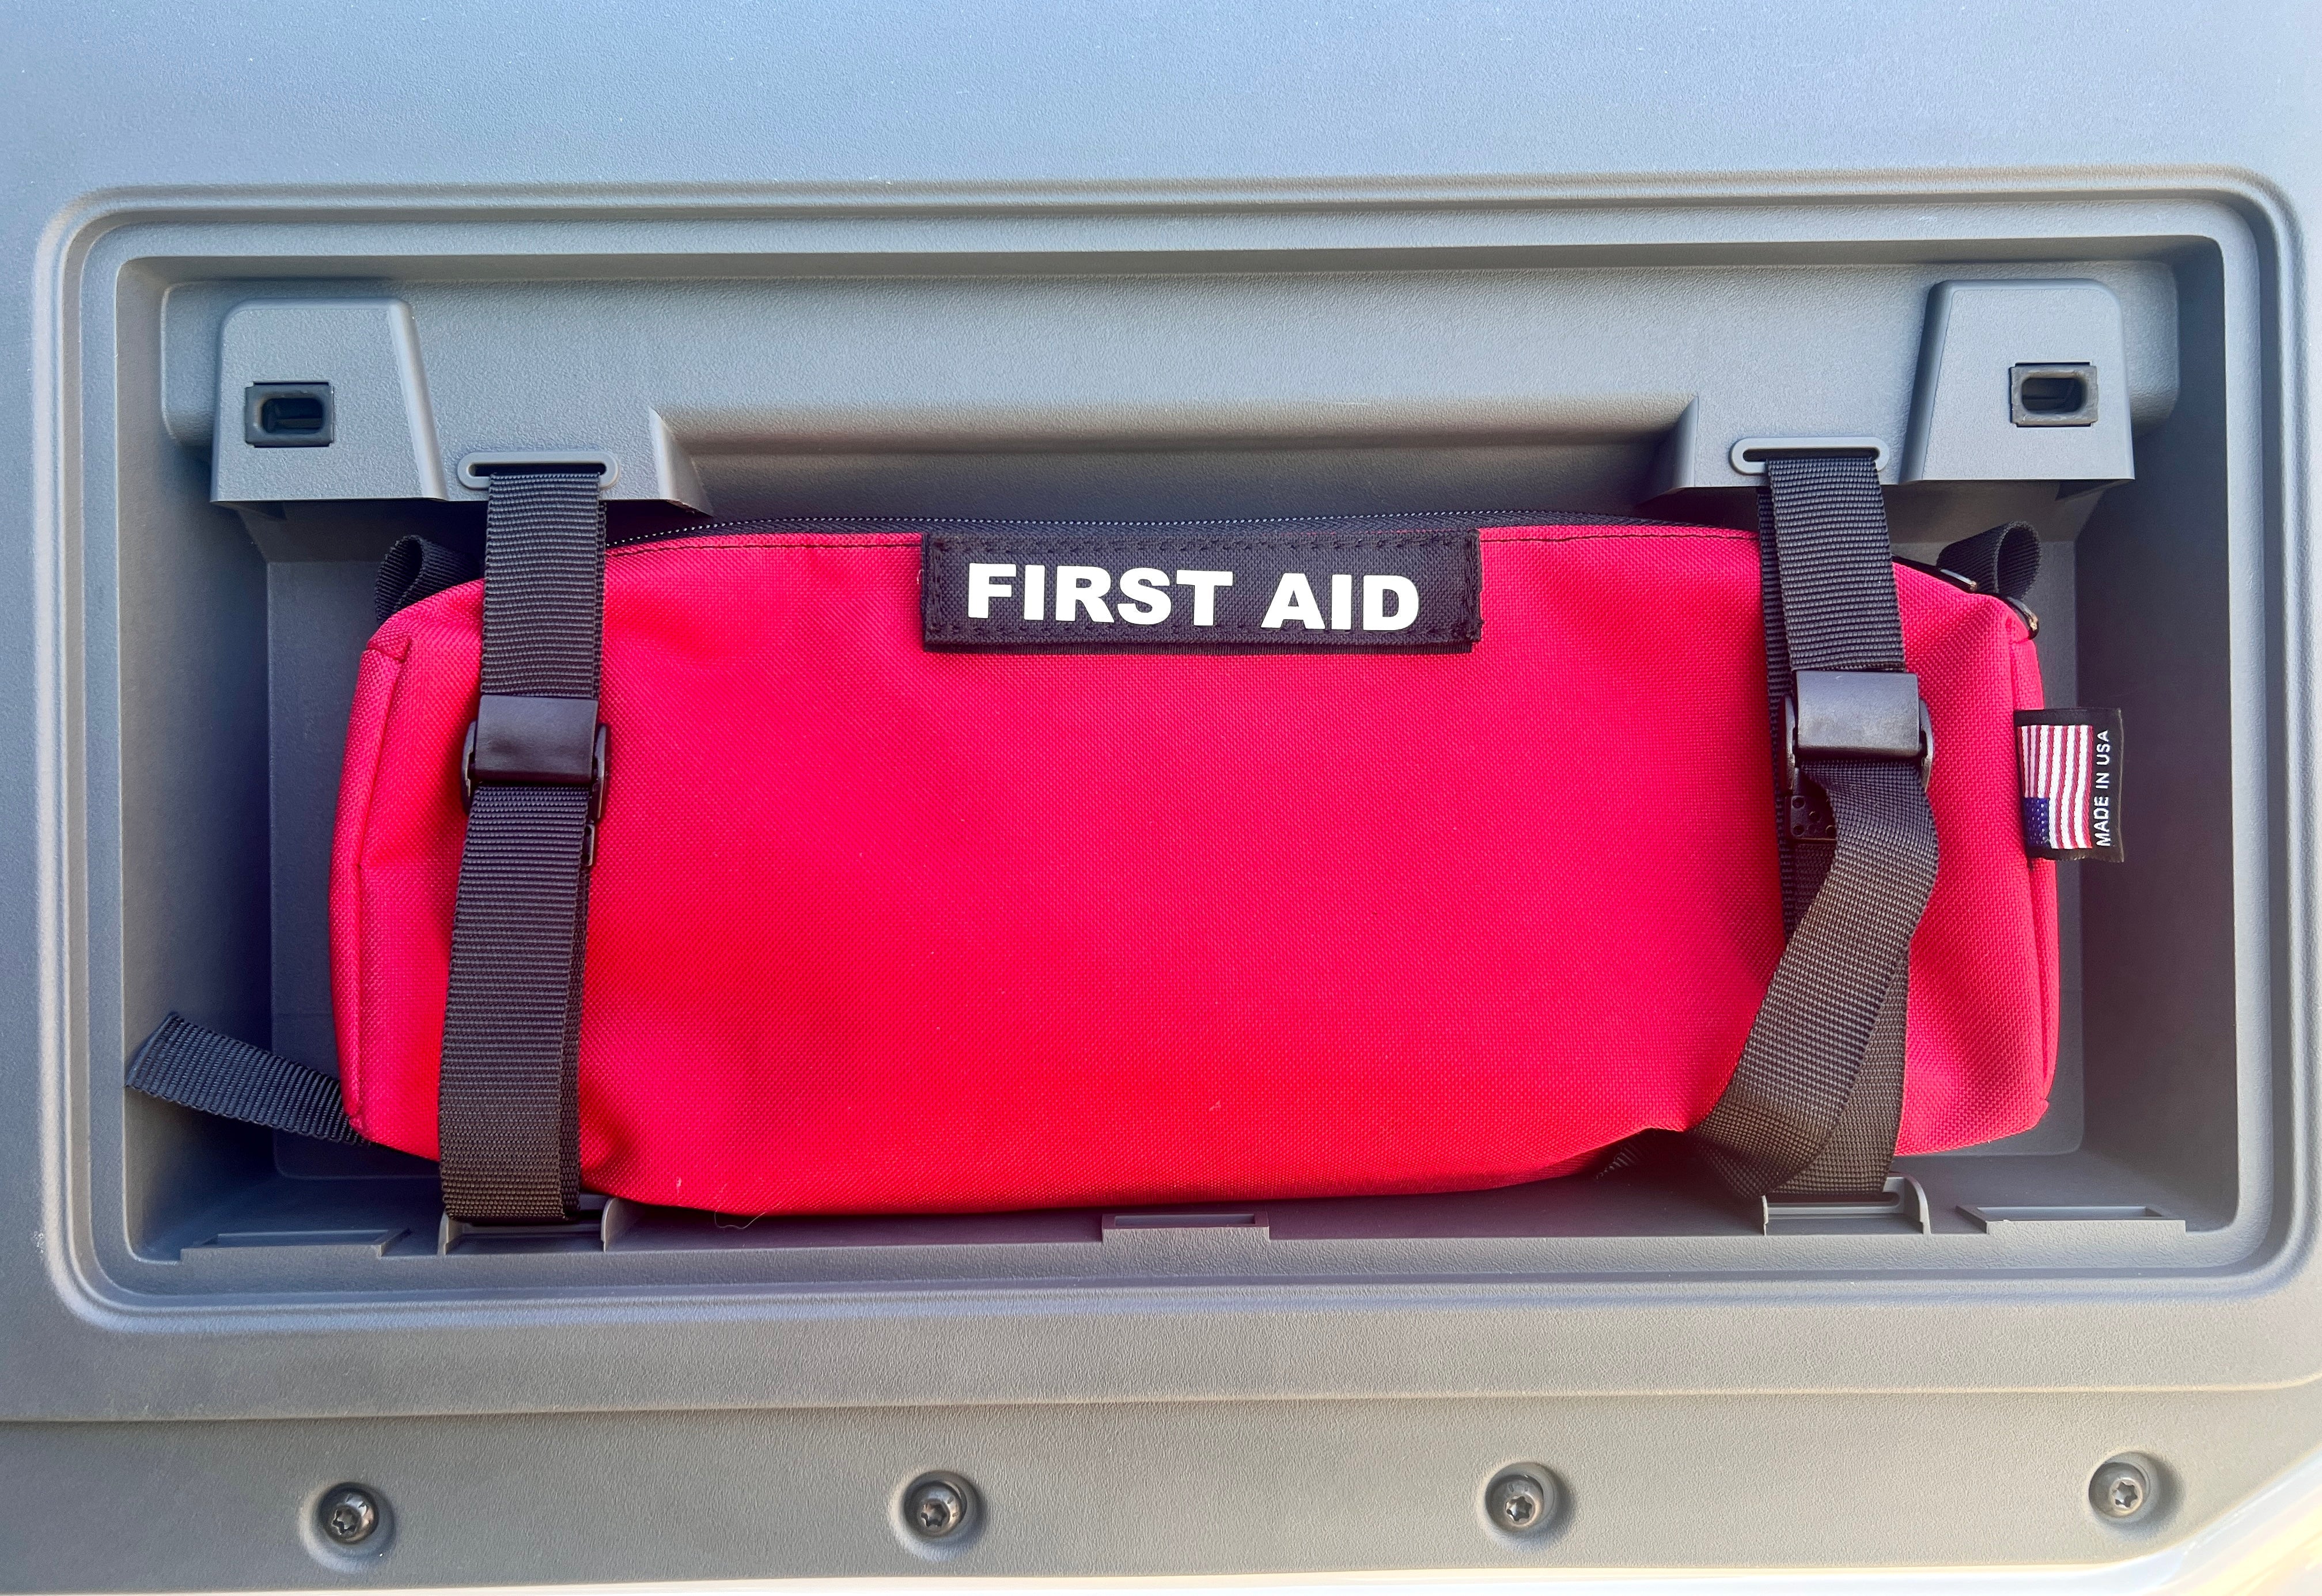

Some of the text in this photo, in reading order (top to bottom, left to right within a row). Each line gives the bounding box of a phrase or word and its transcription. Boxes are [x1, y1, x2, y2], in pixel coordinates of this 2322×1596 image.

[968, 563, 1419, 631] FIRST AID
[2093, 730, 2111, 847] MADE IN USA
